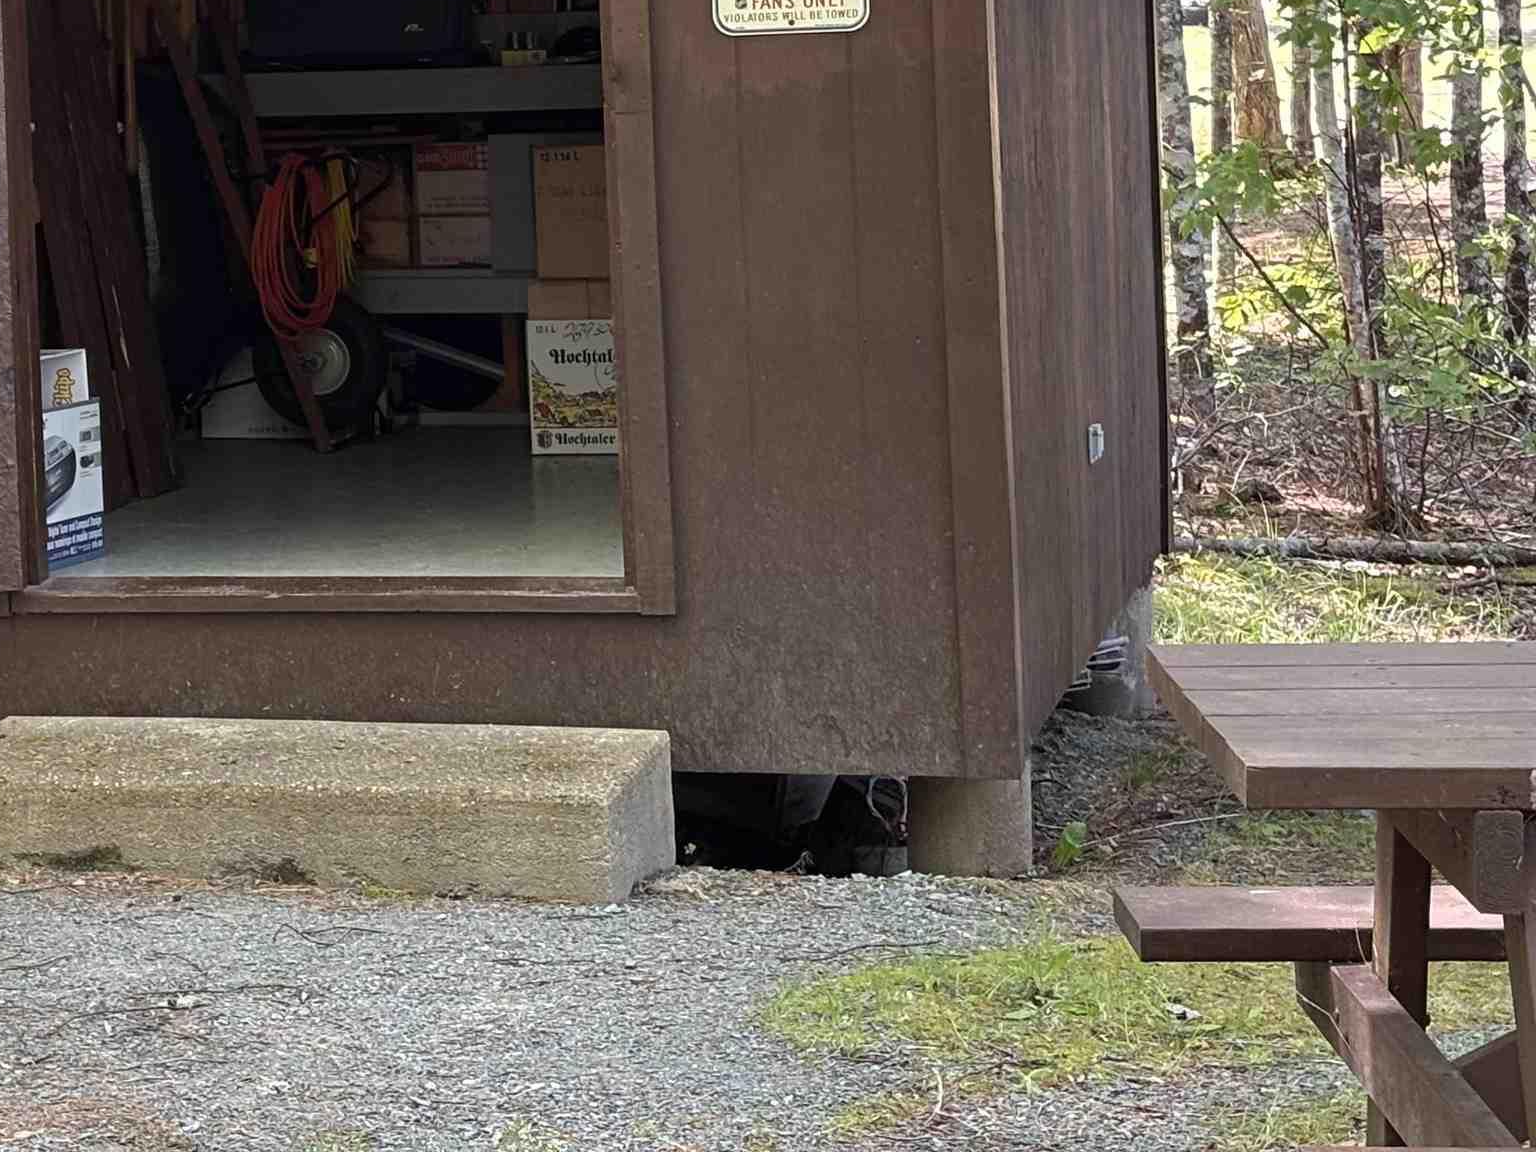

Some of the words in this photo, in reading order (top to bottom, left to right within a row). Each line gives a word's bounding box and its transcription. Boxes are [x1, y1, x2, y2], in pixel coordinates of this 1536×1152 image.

[724, 11, 778, 23] VIOLATORS
[782, 11, 806, 22] WILL
[809, 10, 823, 20] BE
[825, 8, 859, 19] TOWED
[549, 348, 616, 367] Hochtal
